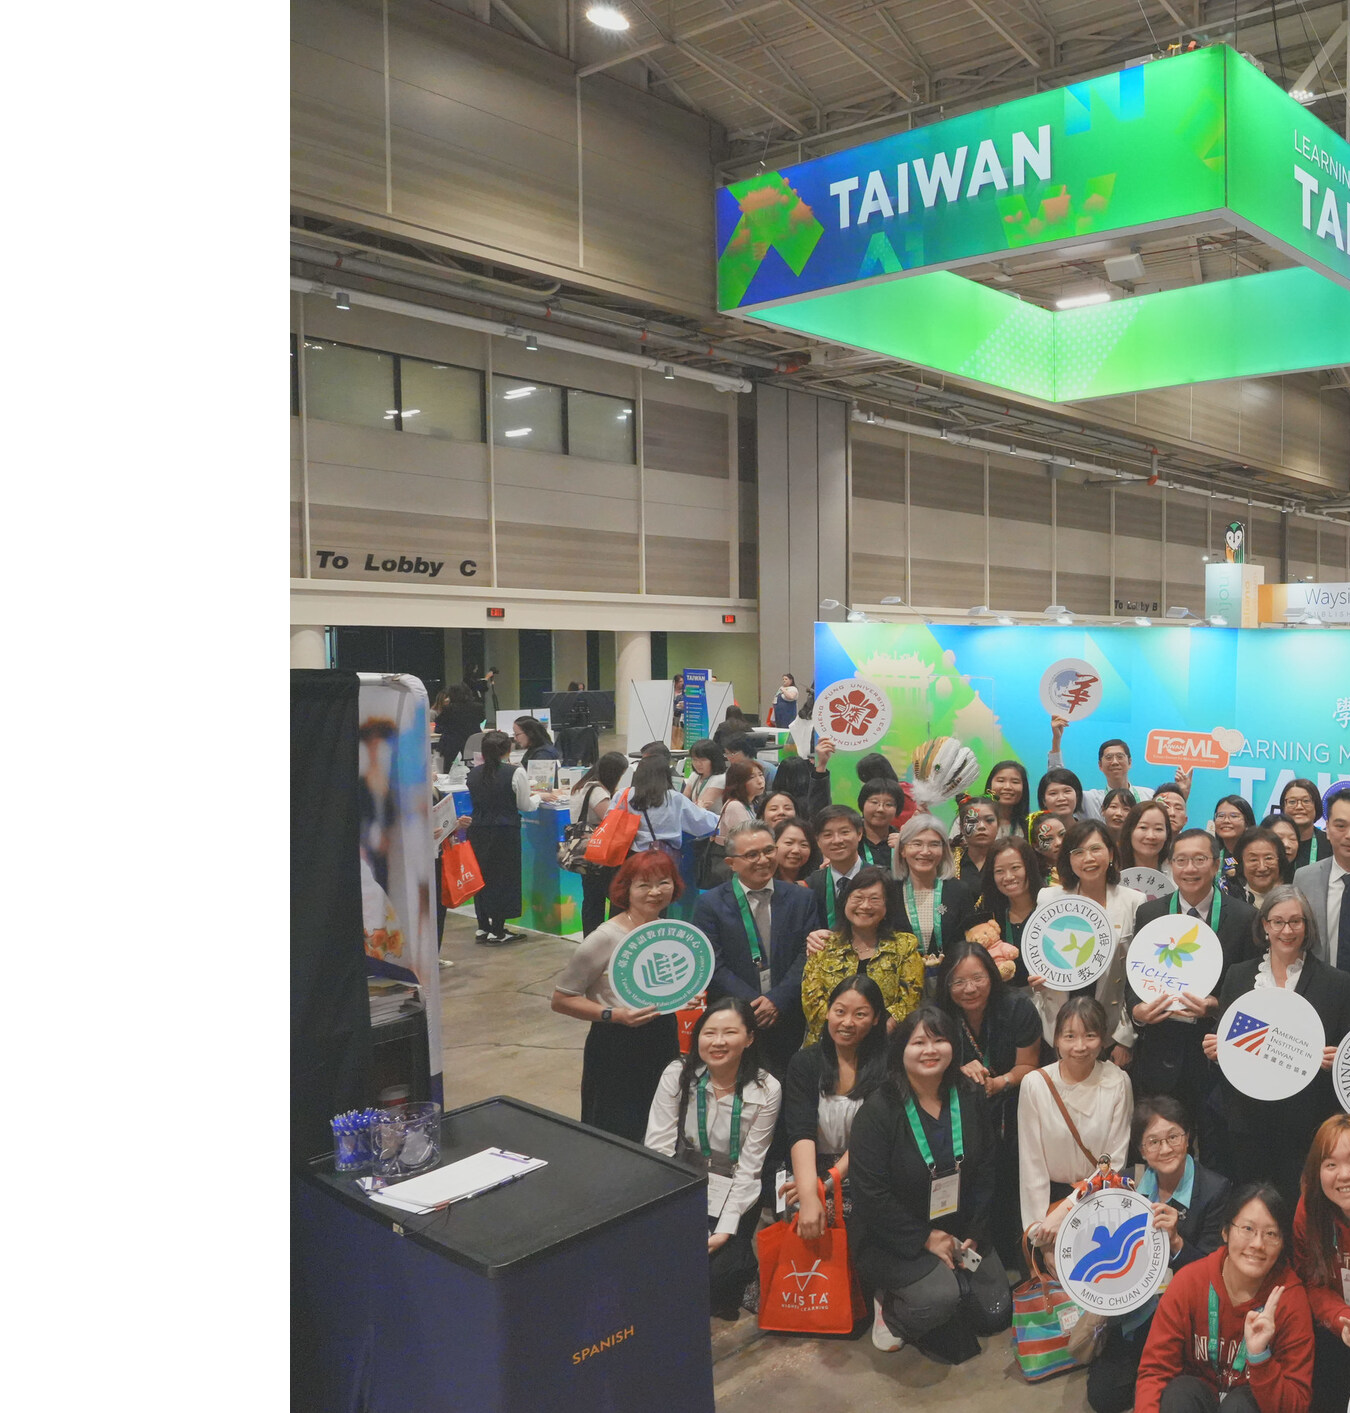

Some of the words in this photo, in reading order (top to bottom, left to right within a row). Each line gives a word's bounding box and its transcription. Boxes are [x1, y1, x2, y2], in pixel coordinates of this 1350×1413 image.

[829, 124, 1051, 229] TAIWAN
[316, 550, 349, 570] To
[364, 553, 444, 578] Lobby
[459, 560, 477, 577] C
[1114, 600, 1124, 610] To
[1152, 602, 1158, 612] B
[823, 684, 845, 700] KUNG
[850, 683, 887, 712] UNIVERSITY
[817, 704, 828, 733] CHENG
[829, 734, 869, 747] NATIONAL
[1153, 735, 1220, 759] TCML
[1230, 738, 1331, 765] ARNING
[1041, 902, 1105, 931] EDUCATION
[1030, 922, 1043, 941] OF
[1028, 942, 1073, 983] MINISTRY
[1077, 932, 1111, 982] 教育部
[1131, 960, 1190, 992] FICHET
[1262, 1053, 1308, 1077] 美國在台協會
[1305, 1050, 1313, 1059] IN
[1061, 1197, 1133, 1260] 銘傳大學
[1080, 1288, 1104, 1306] MING
[1108, 1288, 1142, 1307] CHUAN
[1141, 1229, 1162, 1289] UNIVERSITY
[781, 1290, 829, 1307] VISTA
[572, 1324, 635, 1366] SPANISH
